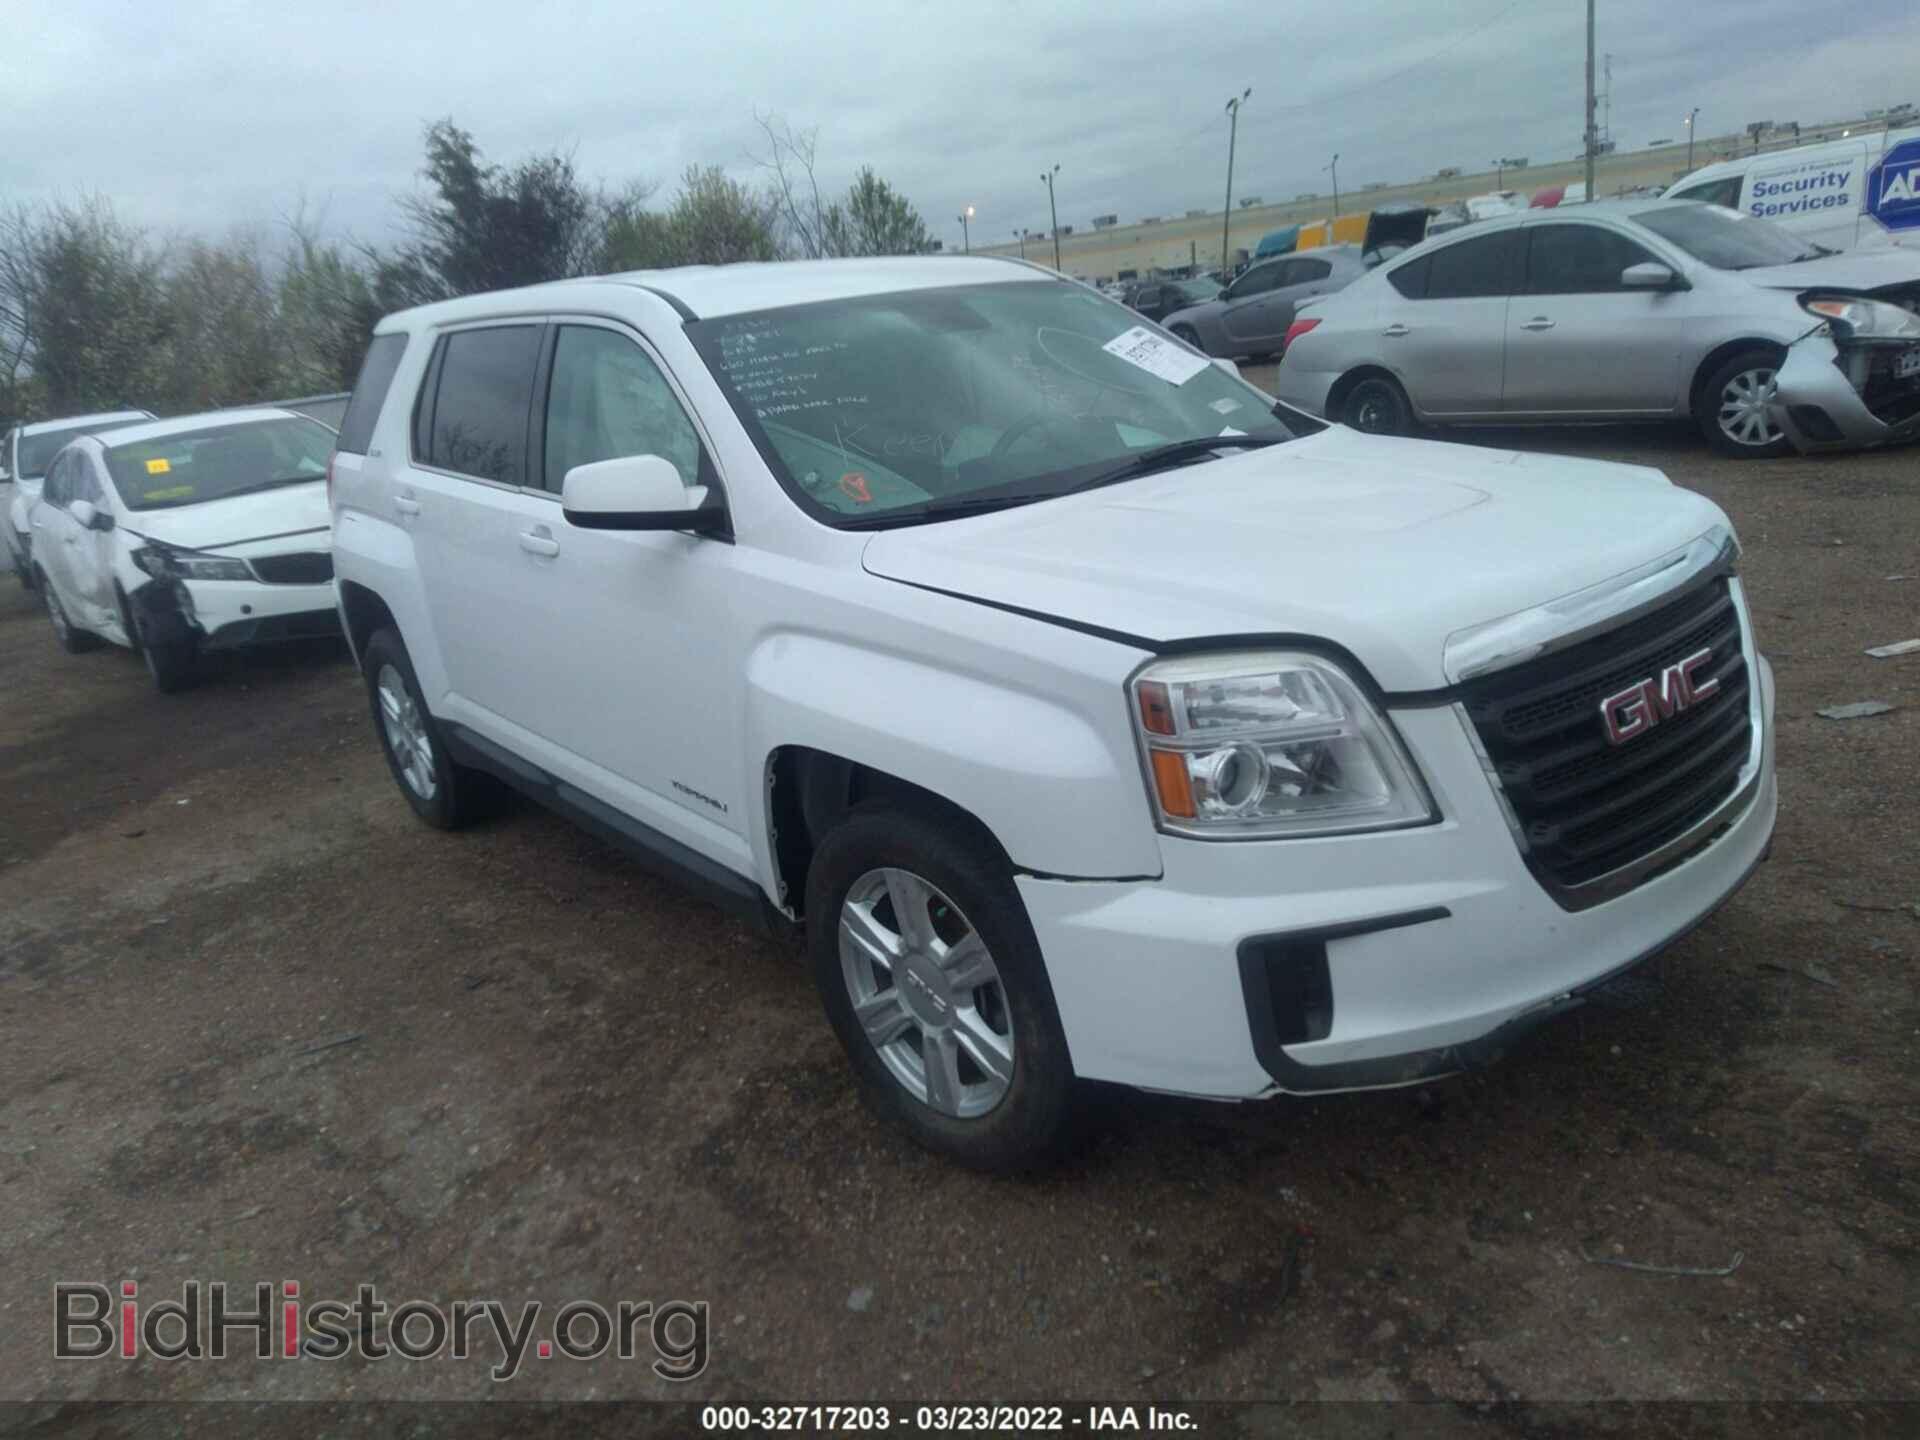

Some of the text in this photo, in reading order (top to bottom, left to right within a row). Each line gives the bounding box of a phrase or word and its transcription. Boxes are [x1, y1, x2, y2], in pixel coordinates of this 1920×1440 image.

[1752, 171, 1850, 198] Security
[1750, 193, 1849, 218] Services
[1600, 647, 1719, 743] GMC
